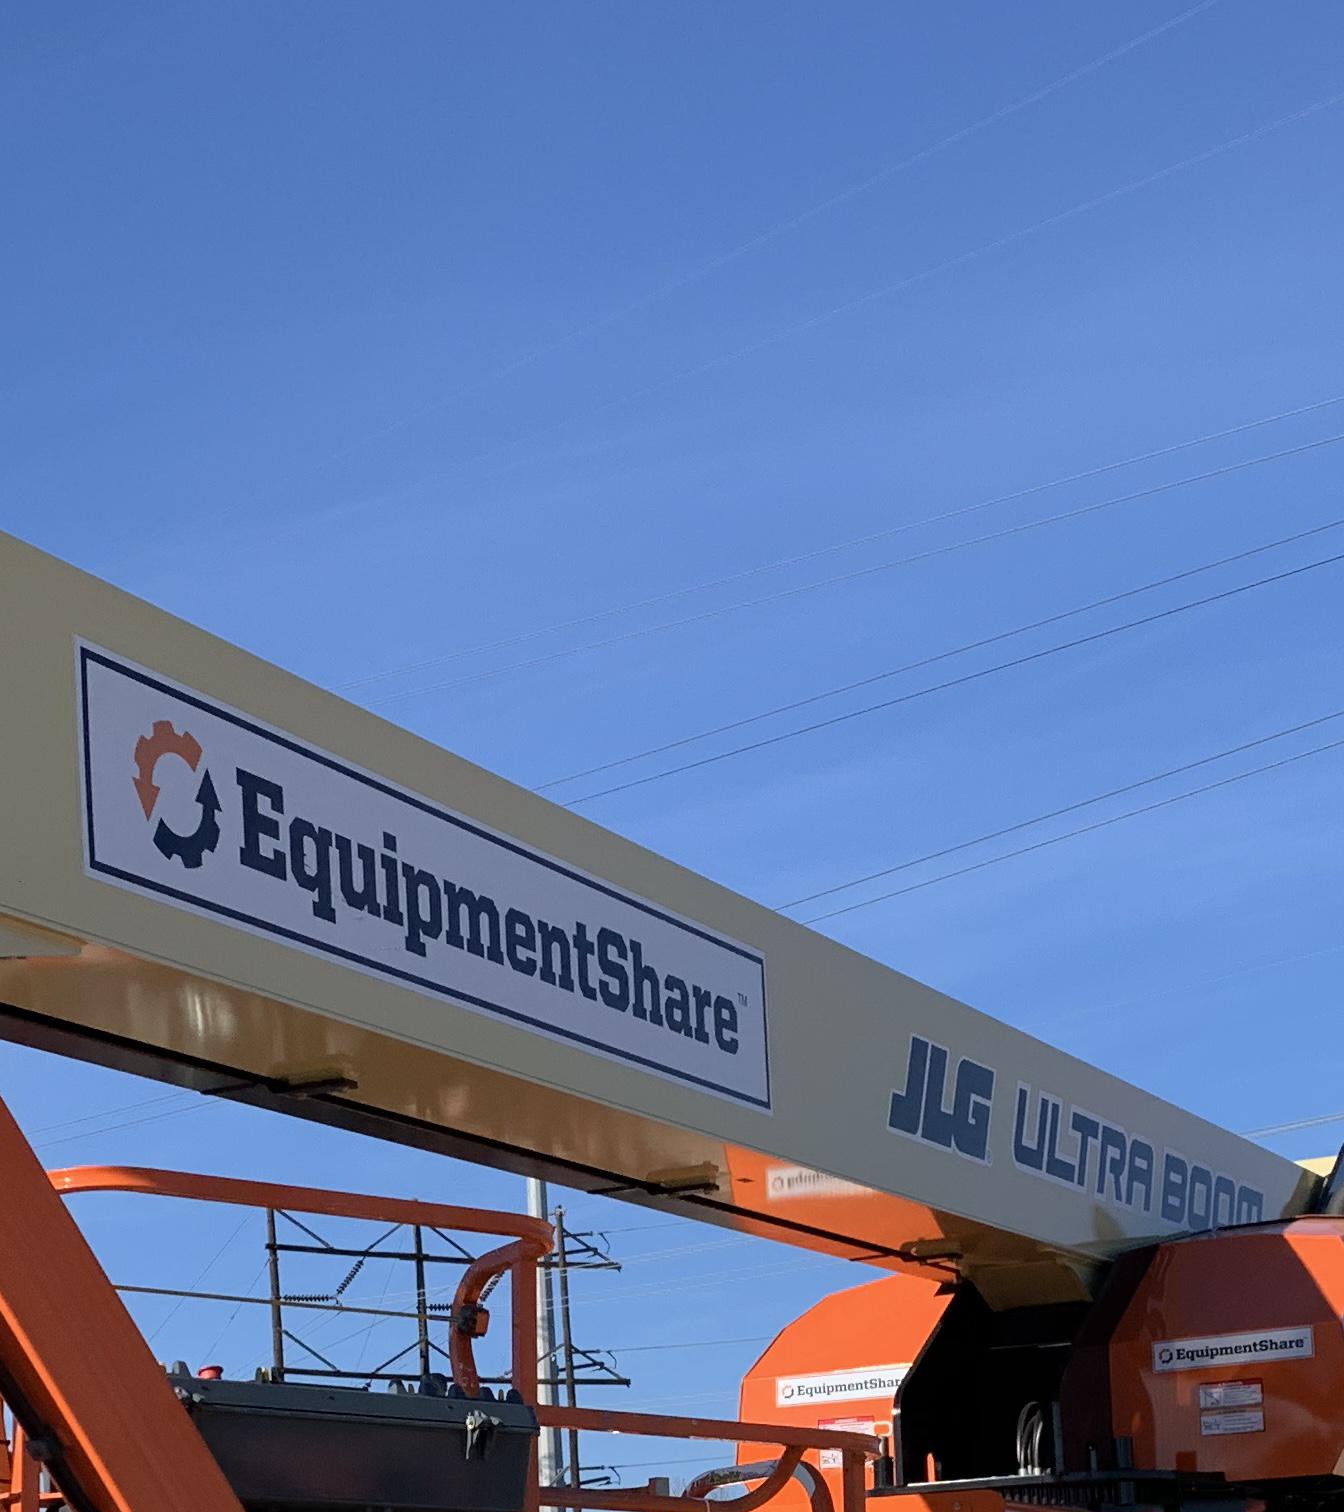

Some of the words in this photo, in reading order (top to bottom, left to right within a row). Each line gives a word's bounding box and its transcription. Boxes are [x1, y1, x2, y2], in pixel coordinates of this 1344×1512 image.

[236, 767, 740, 1055] EquipmentShare
[888, 1036, 995, 1161] JLG
[1014, 1087, 1154, 1212] ULTRA
[1161, 1153, 1264, 1230] BOOM
[797, 1376, 905, 1397] EquipmentShar
[1176, 1338, 1305, 1362] EquipmentShare
